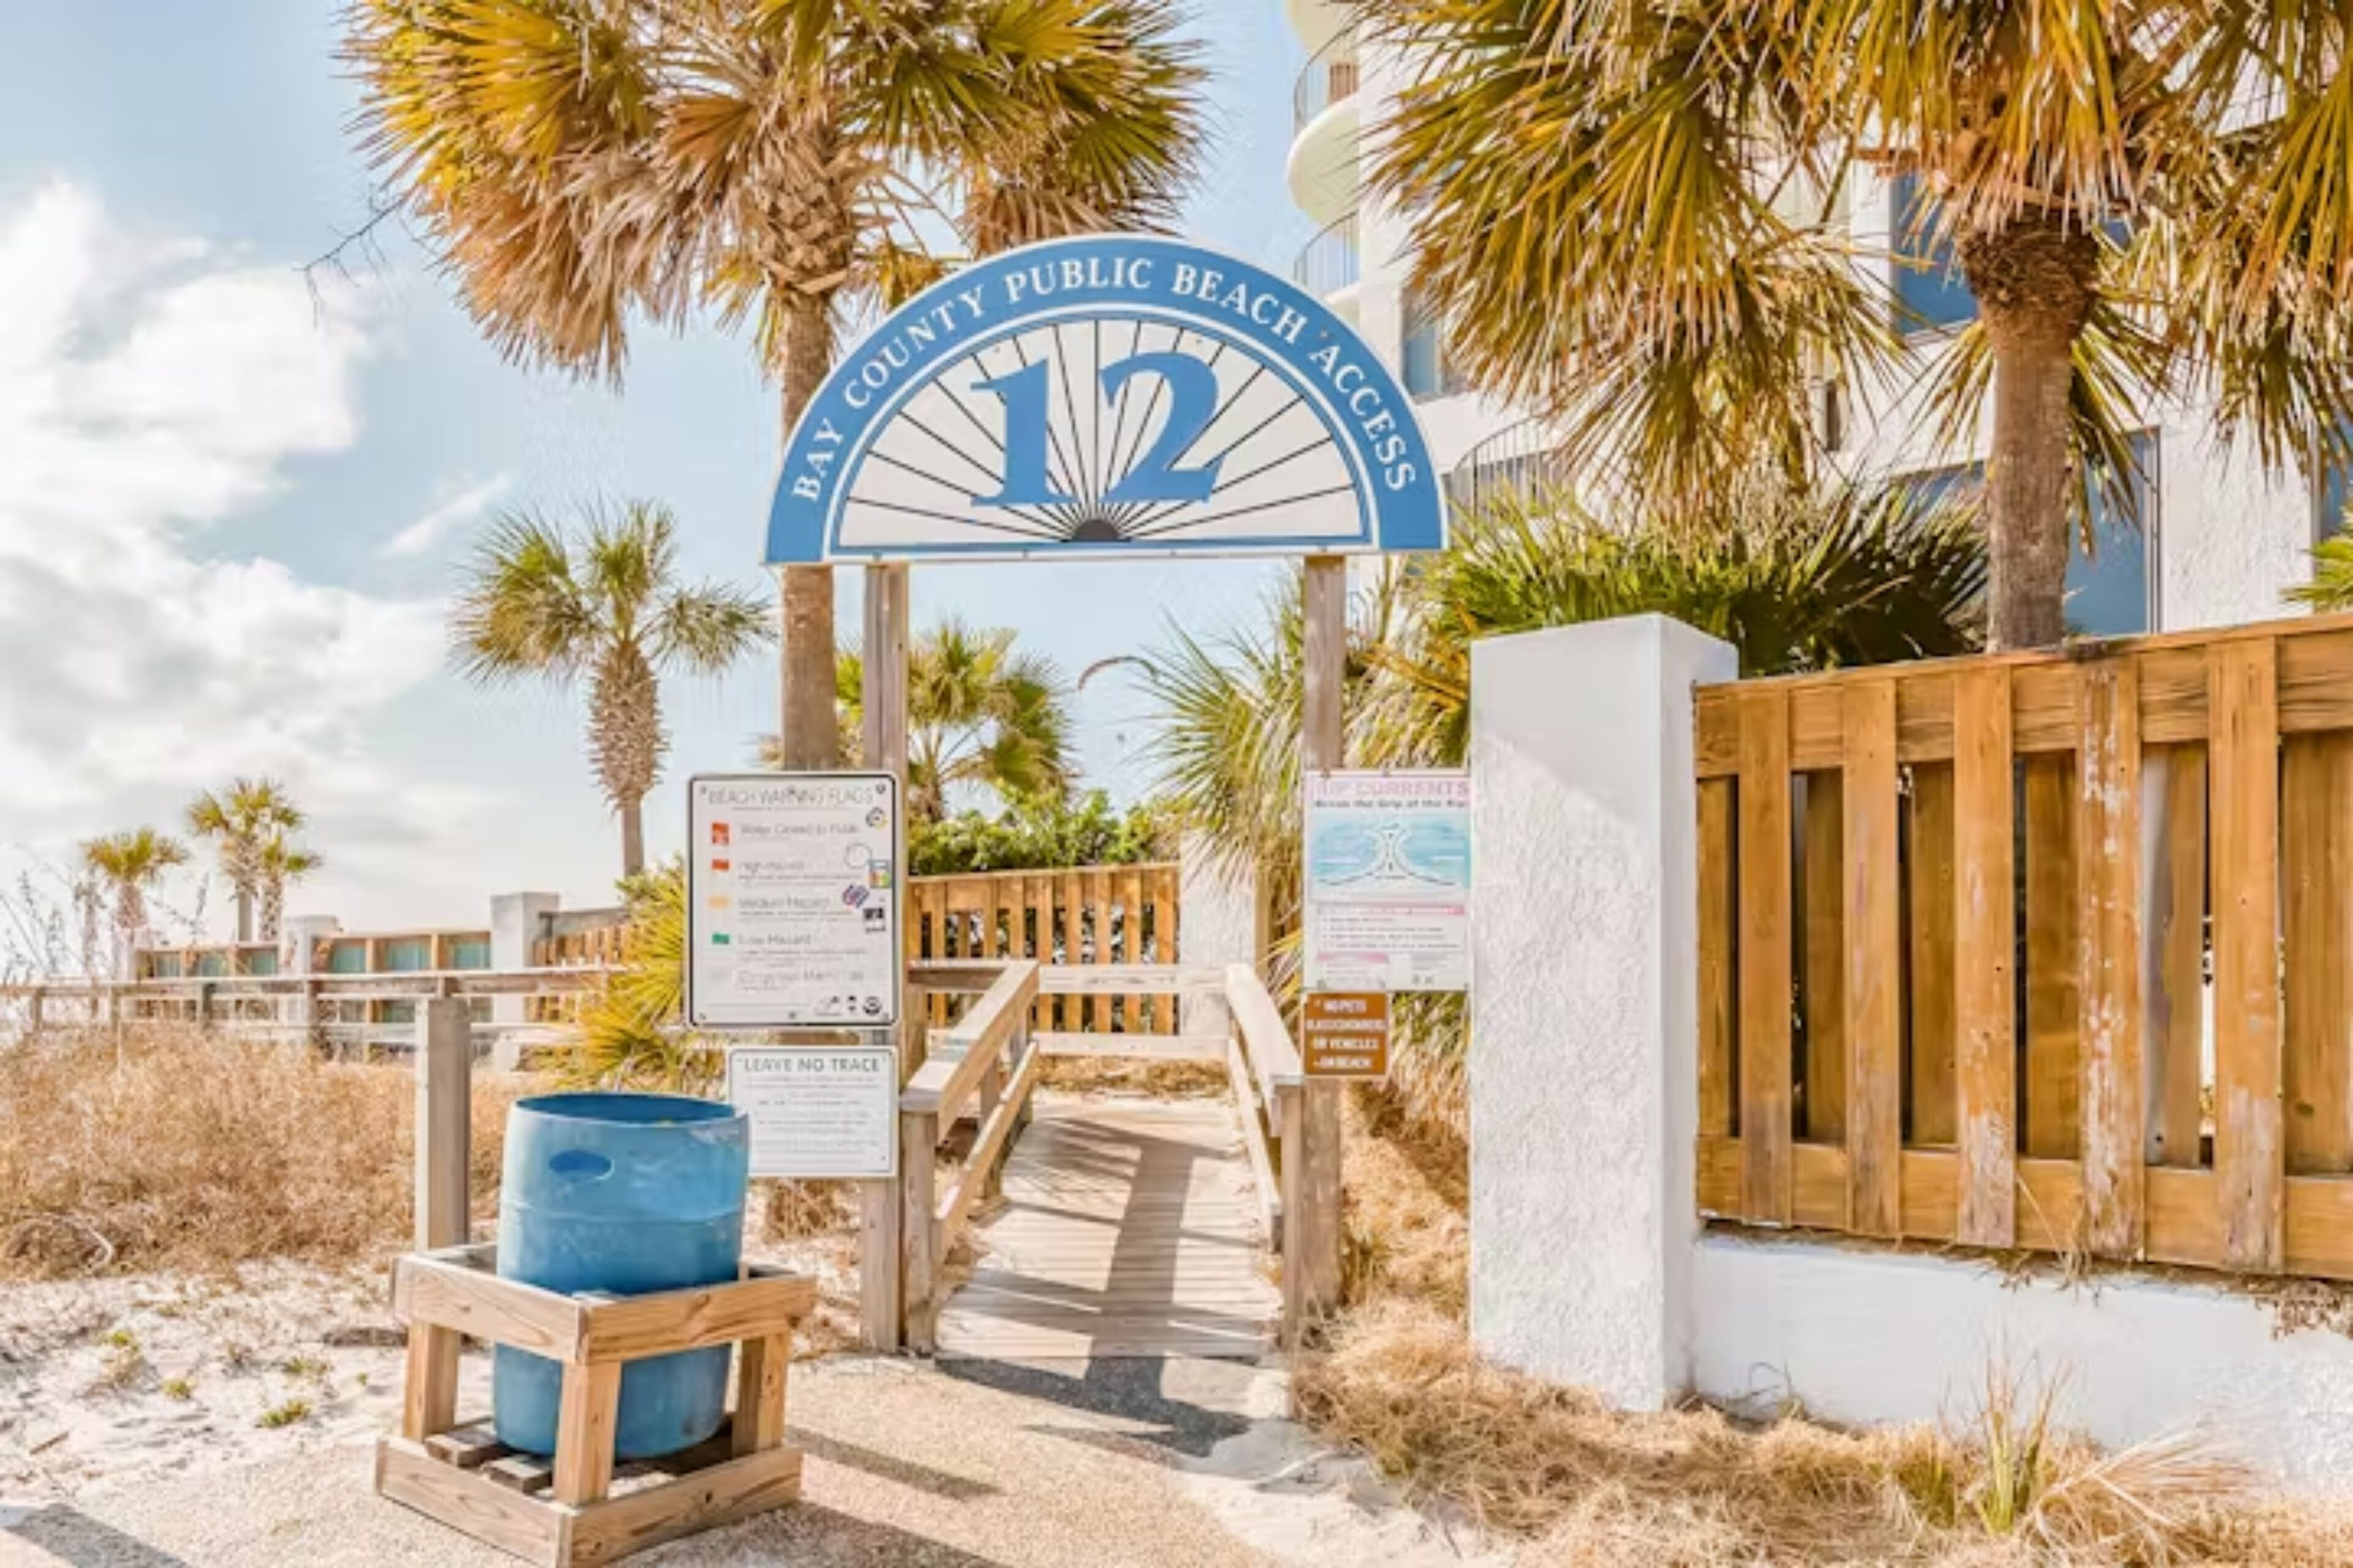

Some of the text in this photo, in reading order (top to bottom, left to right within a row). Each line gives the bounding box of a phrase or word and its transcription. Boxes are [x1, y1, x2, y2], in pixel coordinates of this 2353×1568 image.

[792, 256, 1415, 502] BAY COUNTY PUBLIC BEACH ACCESS
[969, 351, 1226, 507] 12
[708, 787, 874, 805] BEACH WARNING FLAGS
[1356, 781, 1469, 795] CURRENTS
[744, 1058, 879, 1072] LEAVE NO TRACE
